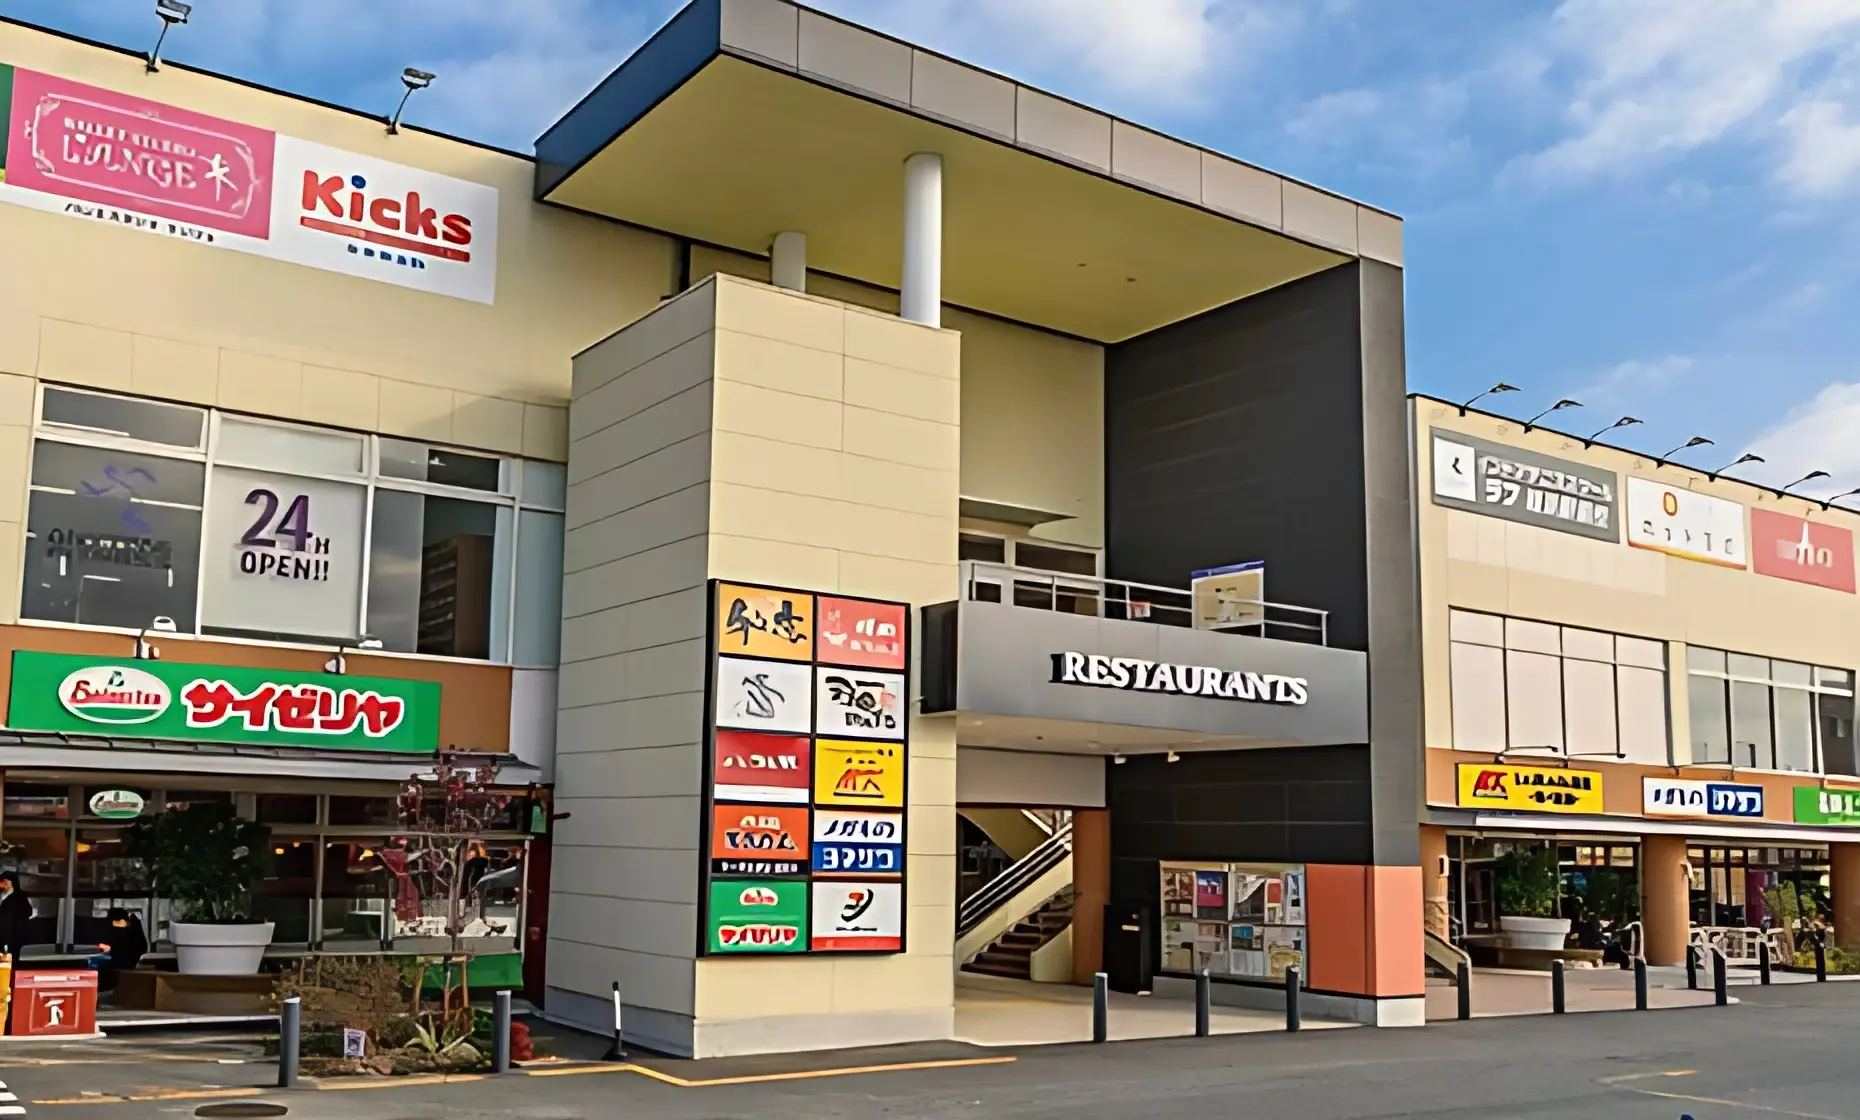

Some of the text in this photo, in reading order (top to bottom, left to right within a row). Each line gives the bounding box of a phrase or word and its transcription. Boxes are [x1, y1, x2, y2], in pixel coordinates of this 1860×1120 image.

[301, 169, 472, 245] Kicks
[240, 551, 329, 581] OPEN!!
[1054, 651, 1308, 706] RESTAURANTS
[183, 681, 403, 735] サイゼリヤ
